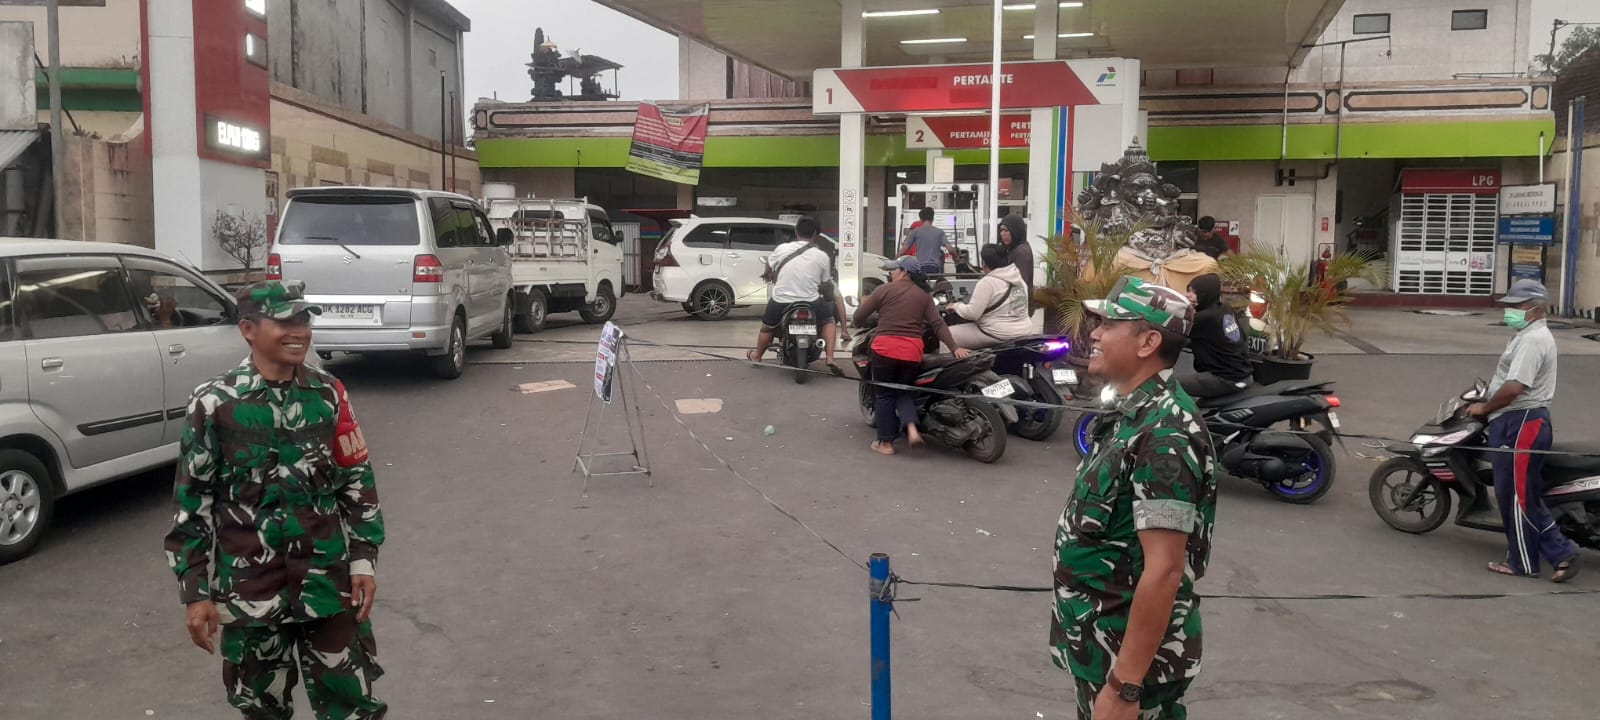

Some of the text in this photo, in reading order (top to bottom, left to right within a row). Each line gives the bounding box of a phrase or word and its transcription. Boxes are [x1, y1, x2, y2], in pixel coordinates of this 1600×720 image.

[825, 87, 833, 105] 1
[915, 129, 925, 143] 2
[1472, 175, 1494, 187] LPG
[322, 304, 333, 314] DK
